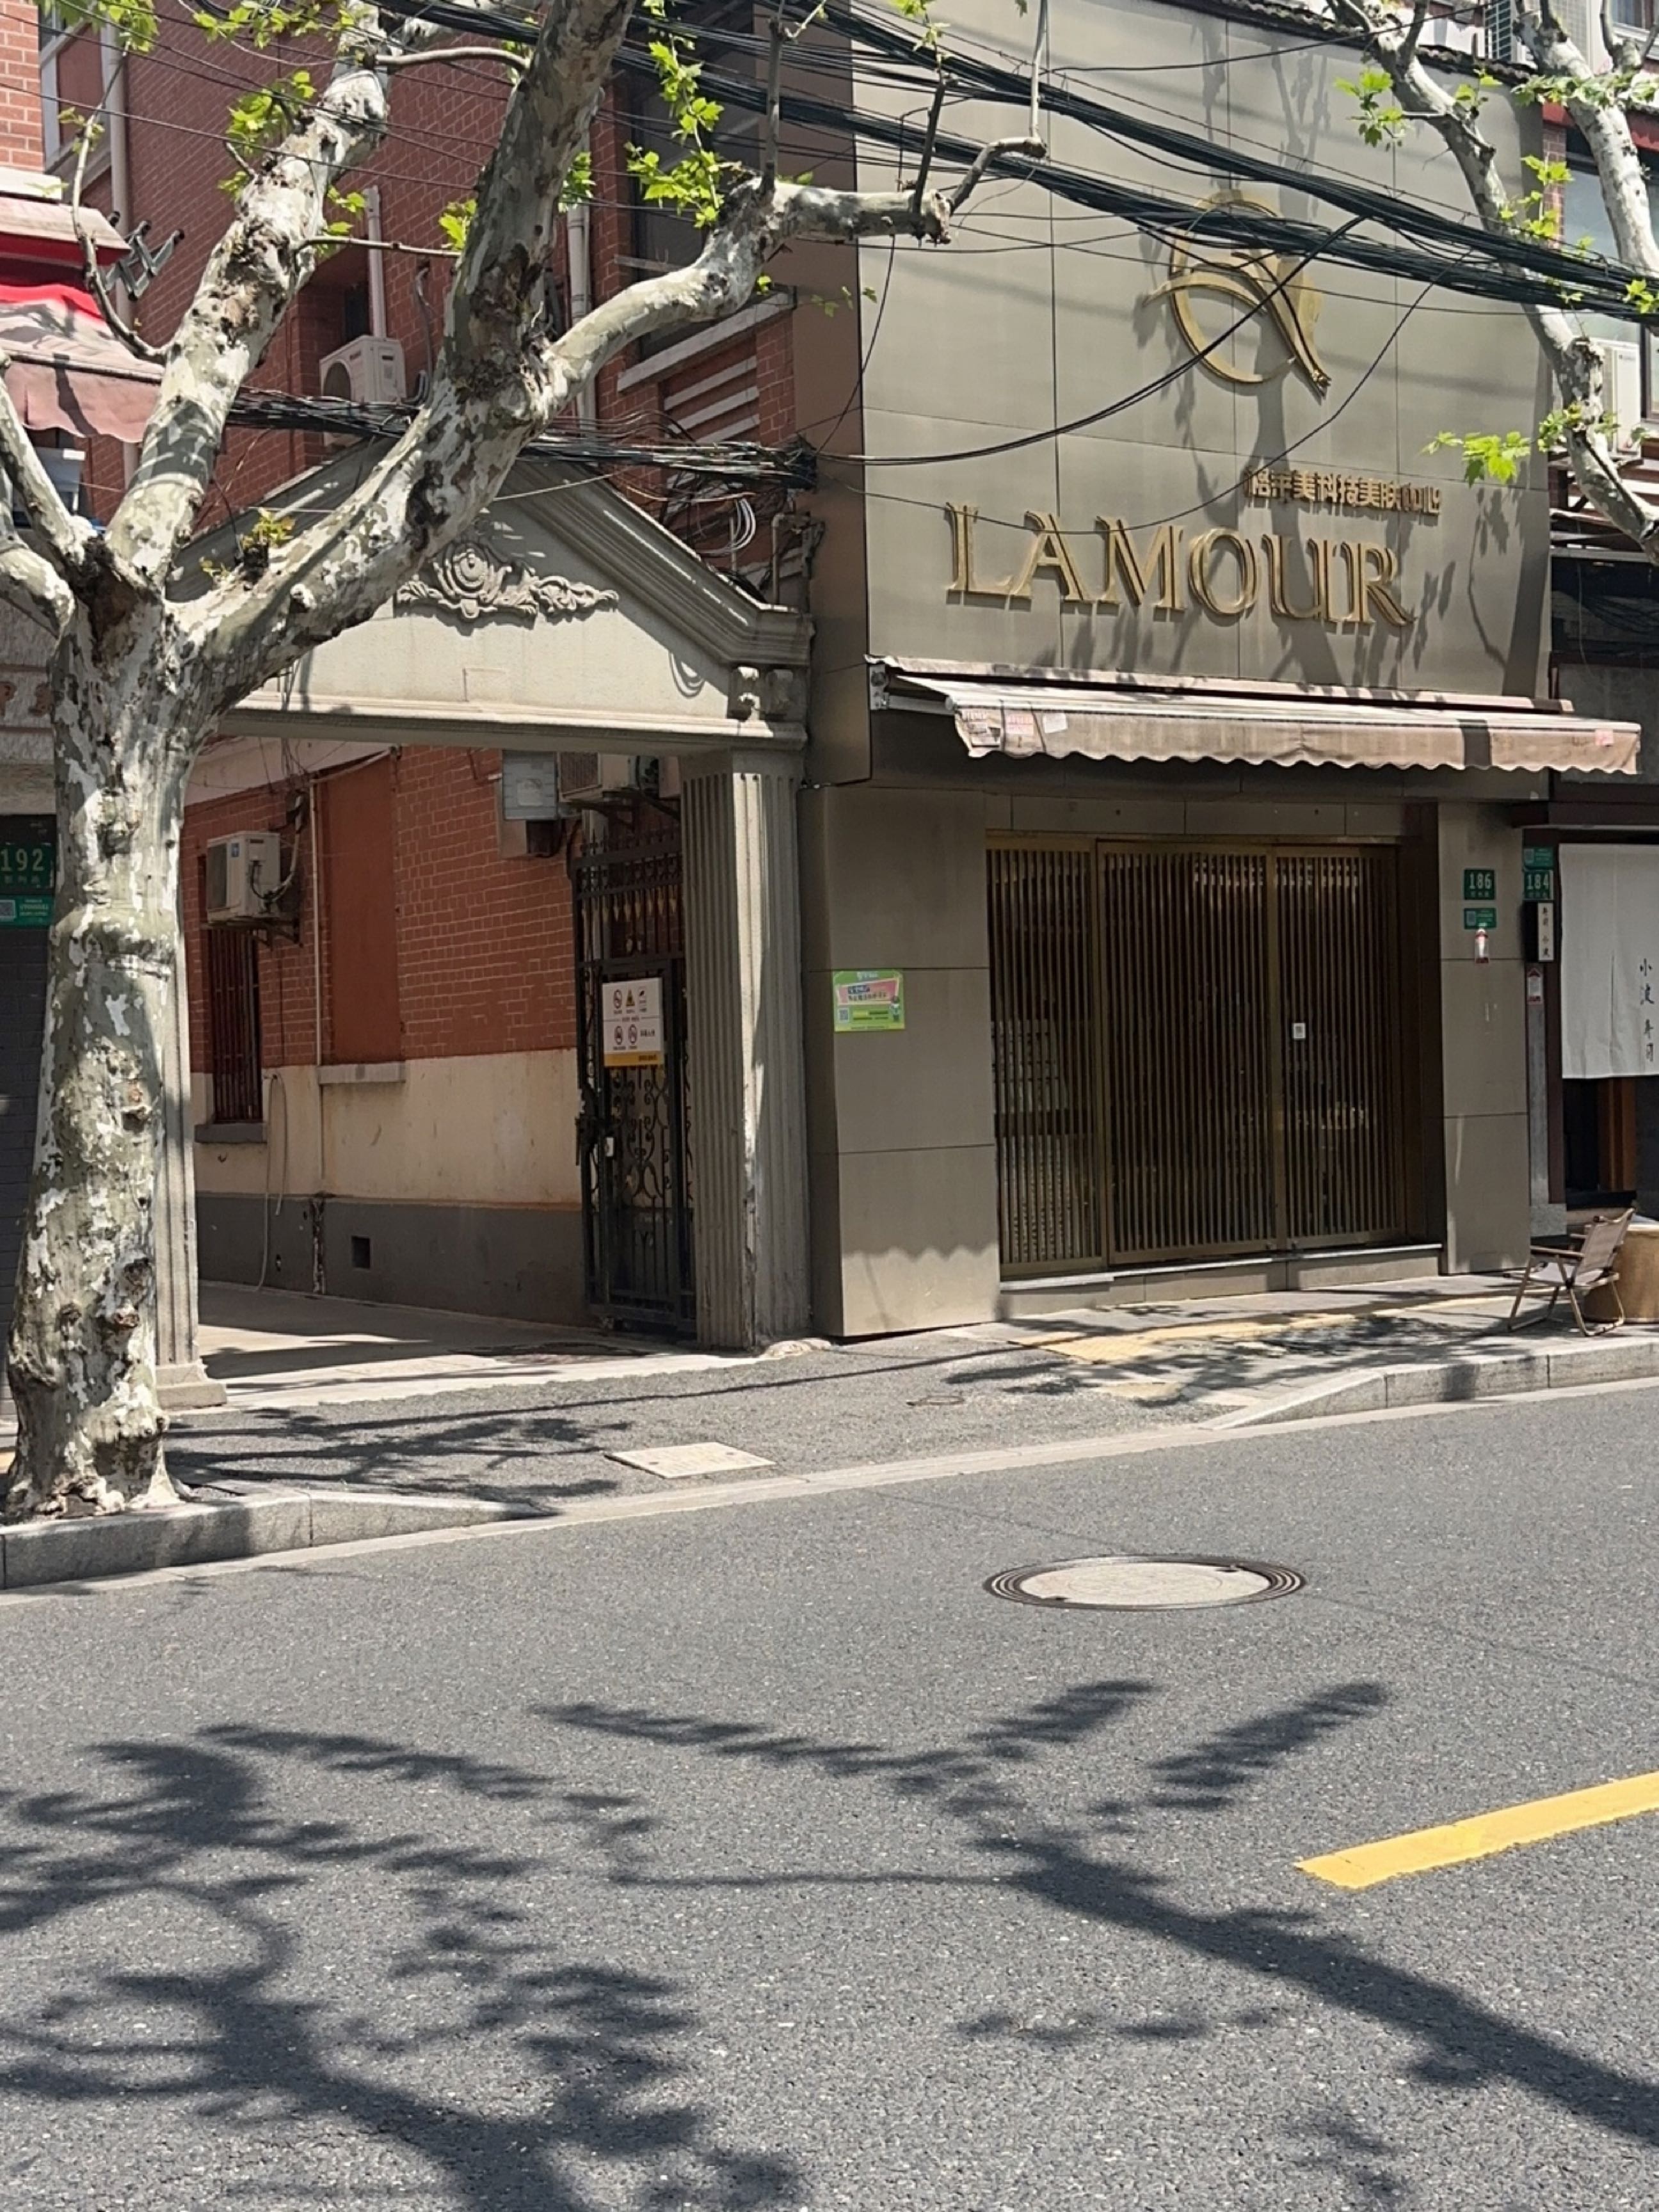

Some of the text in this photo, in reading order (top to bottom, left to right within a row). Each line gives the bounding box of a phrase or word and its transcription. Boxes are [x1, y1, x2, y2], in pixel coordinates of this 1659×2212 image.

[945, 502, 1416, 627] LAMOUR
[0, 848, 45, 871] 192
[1469, 872, 1493, 890] 186
[1526, 874, 1549, 890] 184
